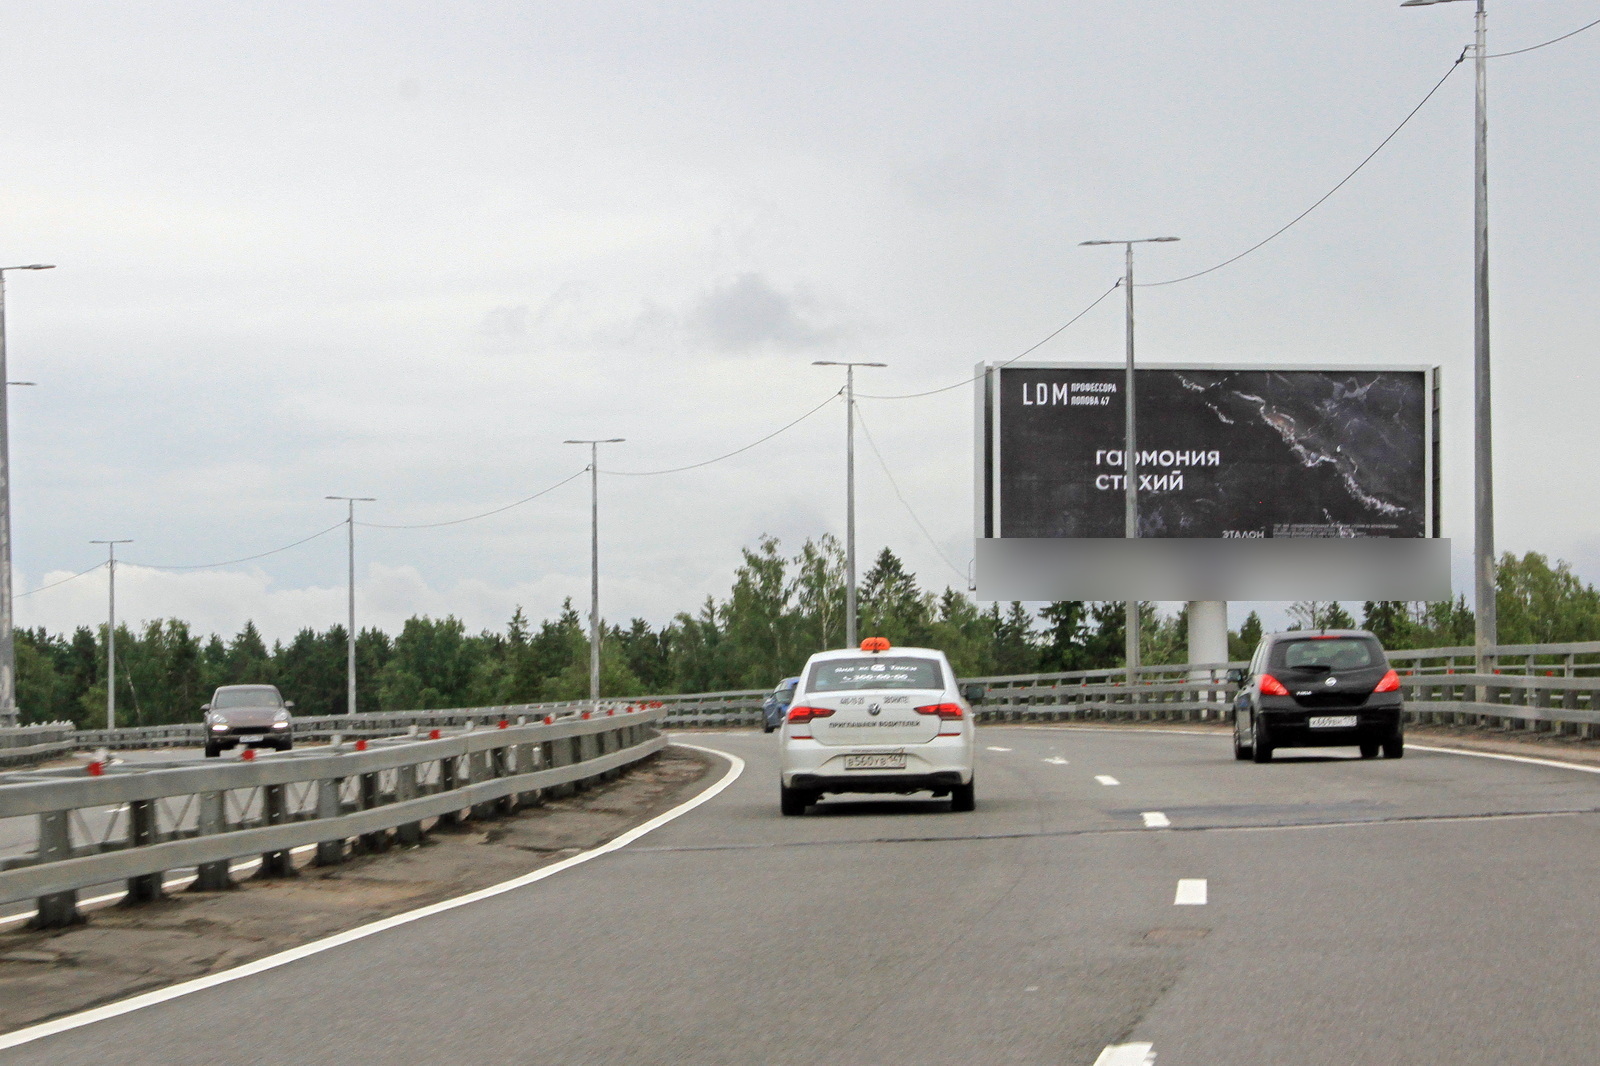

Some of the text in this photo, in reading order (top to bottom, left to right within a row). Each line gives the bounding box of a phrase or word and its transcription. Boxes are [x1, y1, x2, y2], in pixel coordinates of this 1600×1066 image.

[1070, 382, 1117, 393] ПРОФЕССОРА
[1022, 382, 1068, 406] LDM
[1070, 396, 1110, 406] ПОПОВА 47
